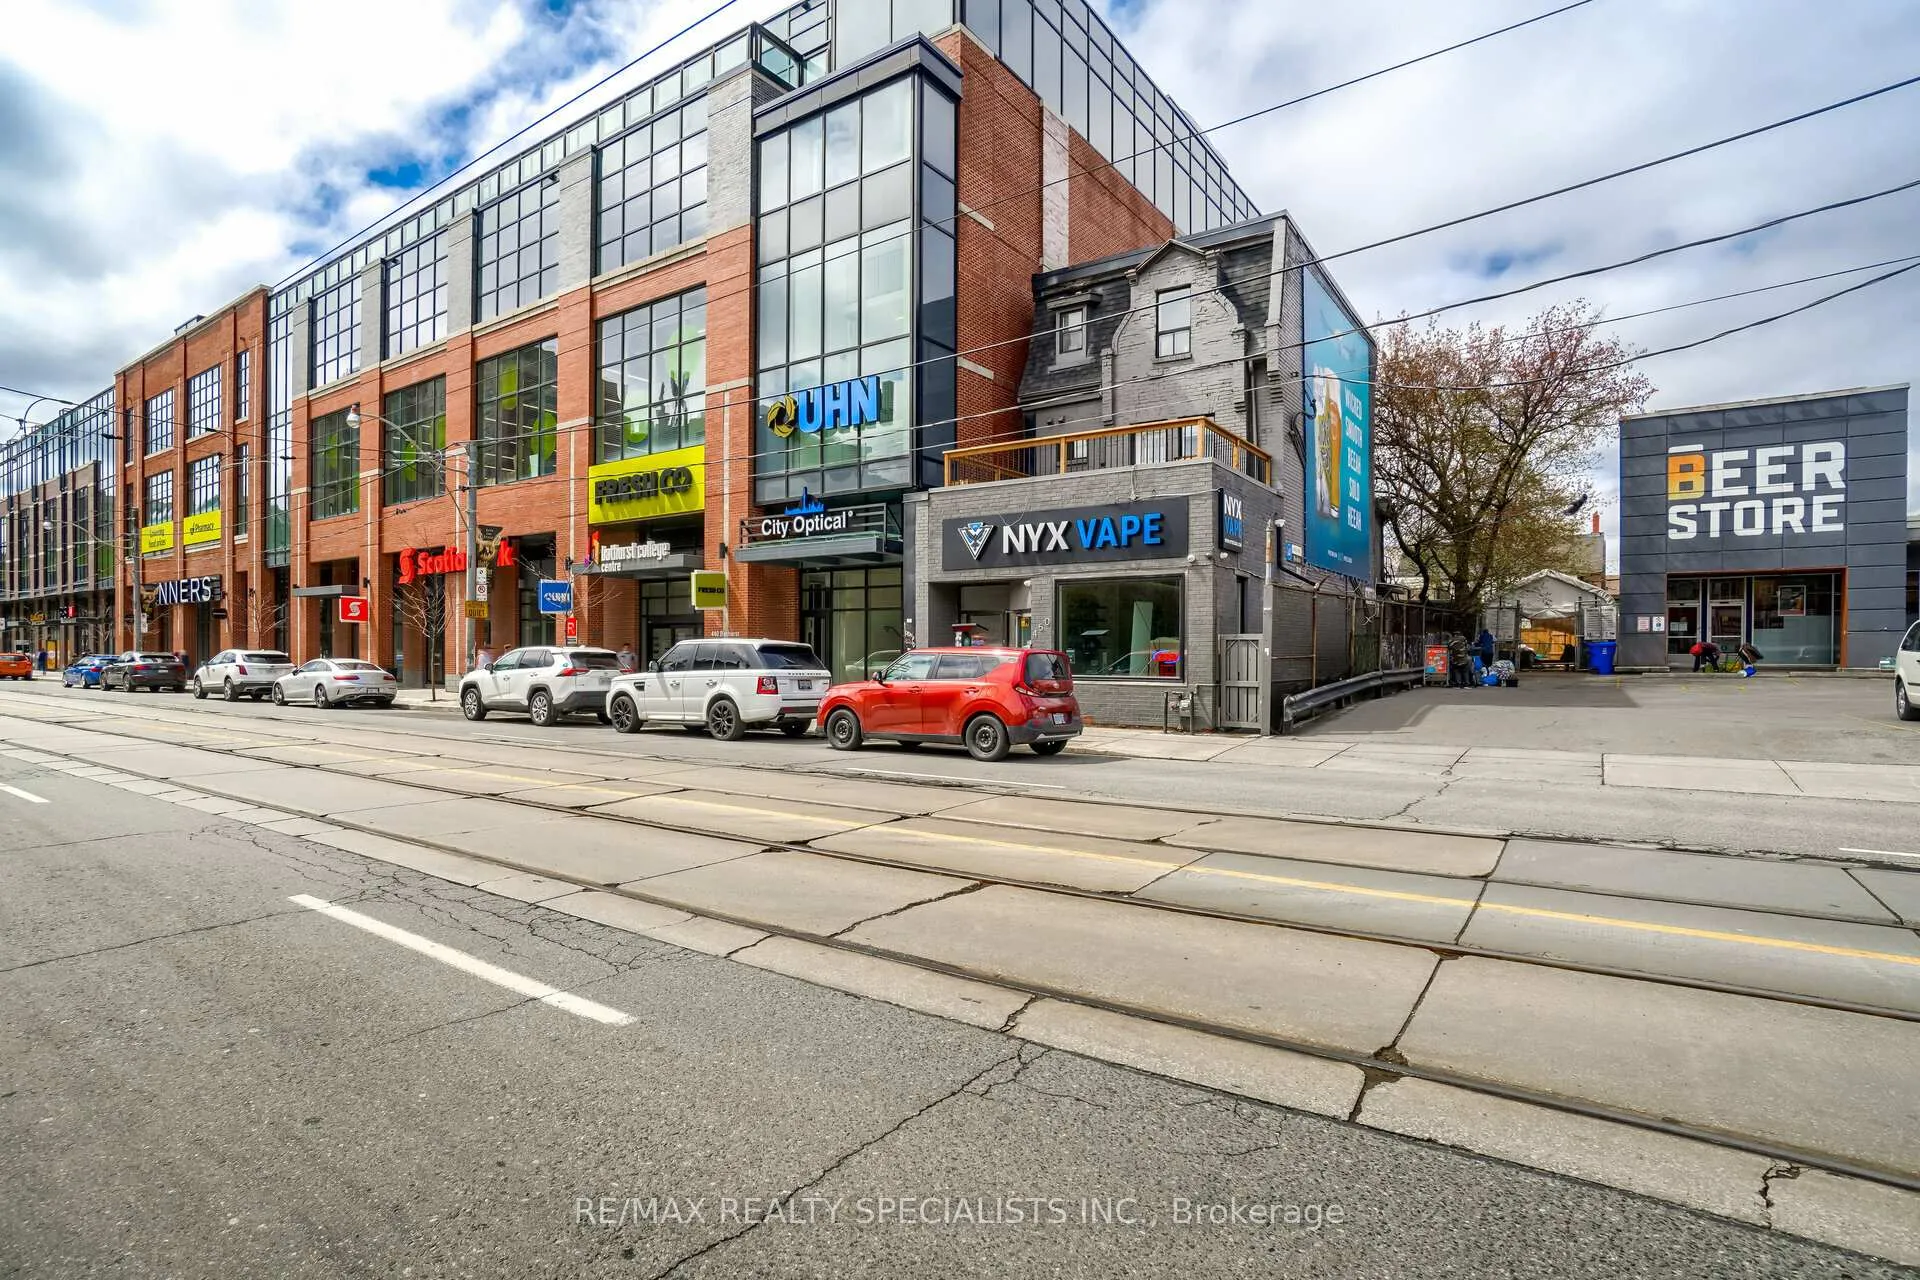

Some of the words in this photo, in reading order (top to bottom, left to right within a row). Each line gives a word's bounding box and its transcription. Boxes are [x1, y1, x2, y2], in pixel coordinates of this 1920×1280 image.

[798, 375, 880, 433] UHN
[1667, 442, 1846, 500] BEER
[1224, 494, 1242, 520] NYX
[1668, 494, 1845, 540] STORE
[761, 517, 789, 538] City
[1002, 520, 1070, 554] NYX
[1077, 512, 1162, 549] VAPE
[417, 540, 514, 575] Scotiak
[601, 561, 621, 572] centre
[157, 576, 212, 605] NNERS
